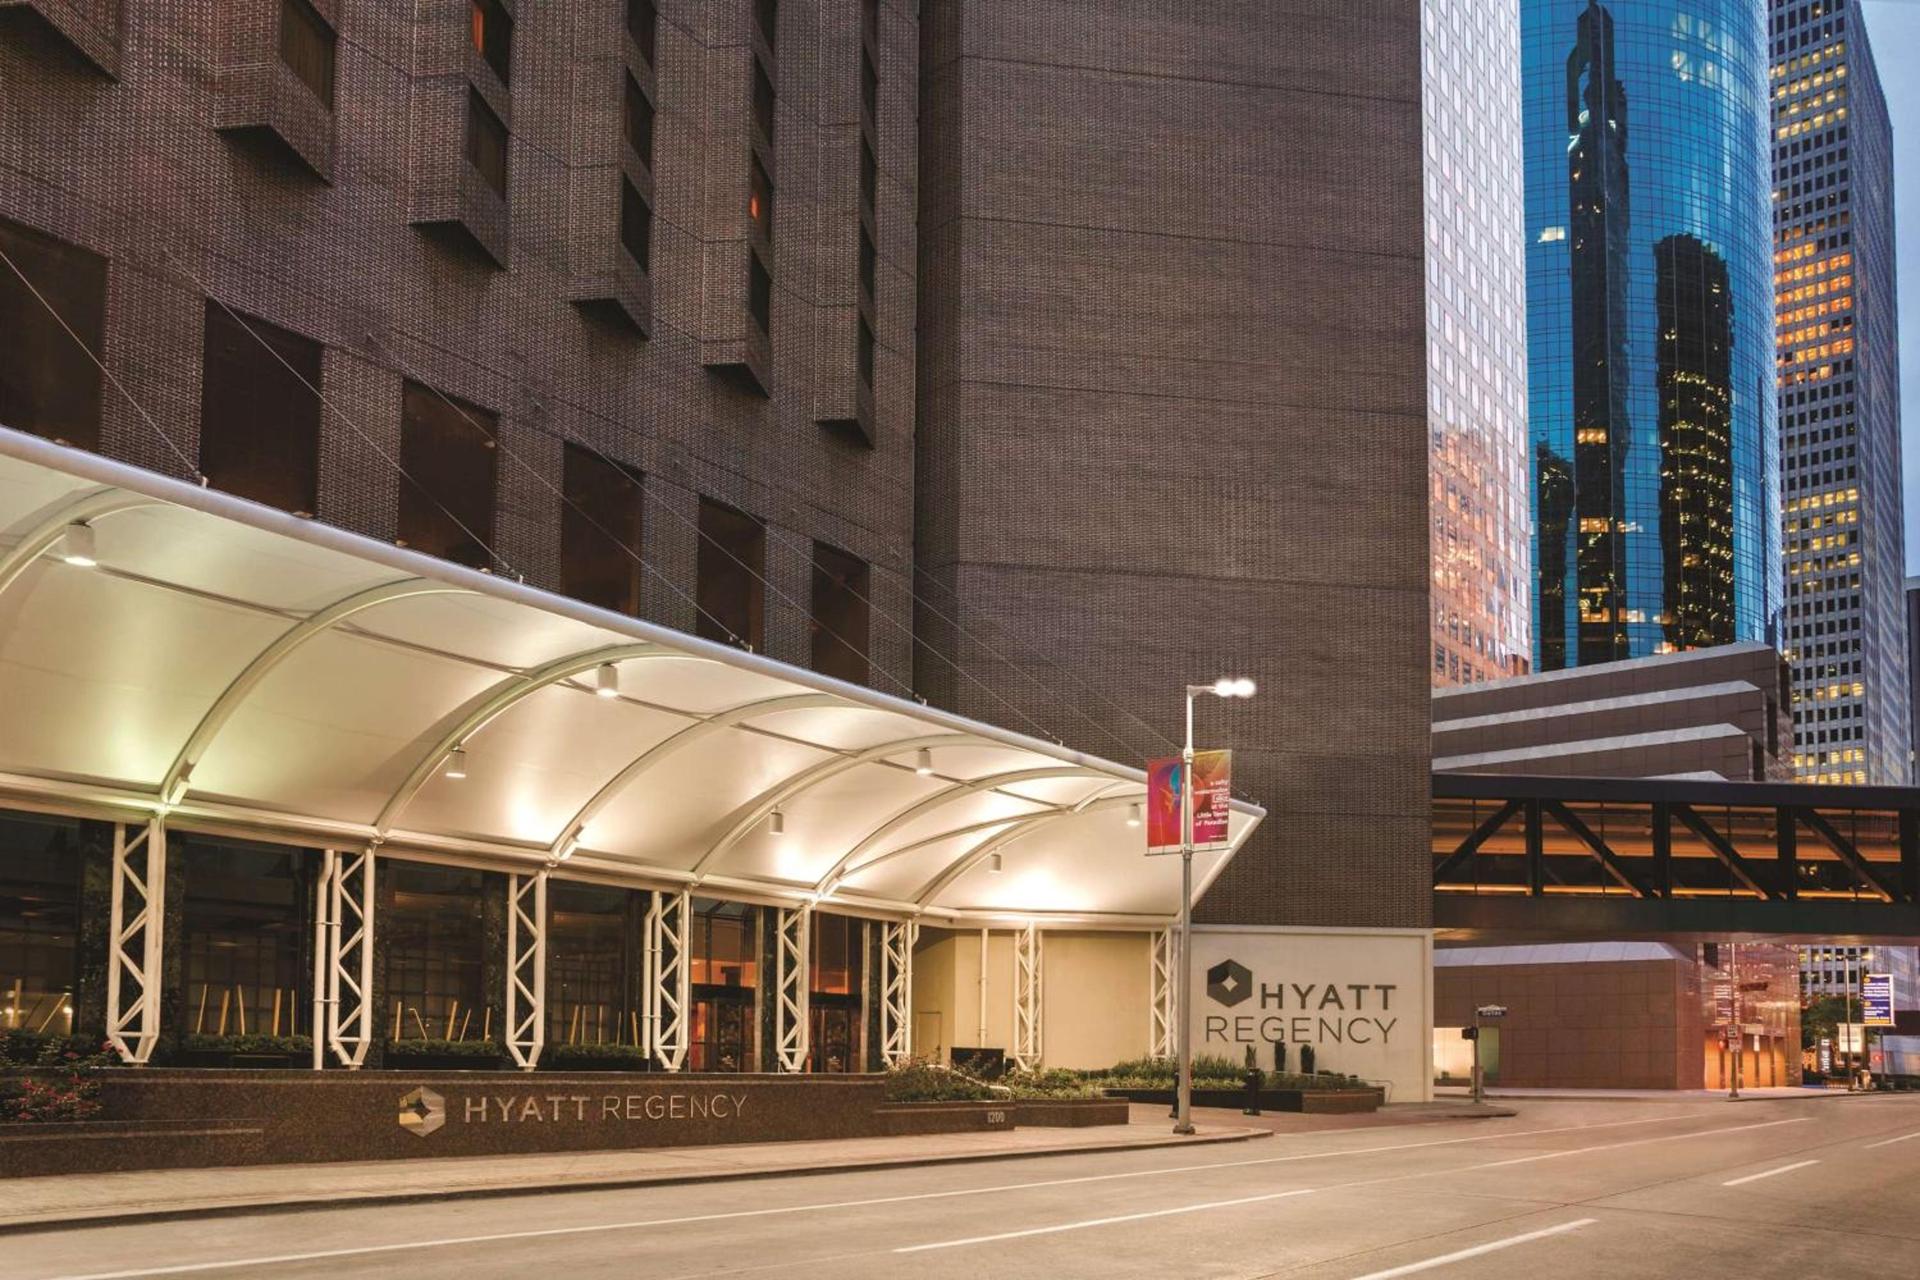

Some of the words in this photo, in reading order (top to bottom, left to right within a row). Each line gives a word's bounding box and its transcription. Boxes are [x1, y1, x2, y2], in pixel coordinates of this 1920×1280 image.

[1260, 983, 1398, 1010] HYATT
[1205, 1015, 1398, 1044] REGENCY
[464, 1096, 591, 1123] HYATT
[601, 1093, 748, 1121] REGENCY
